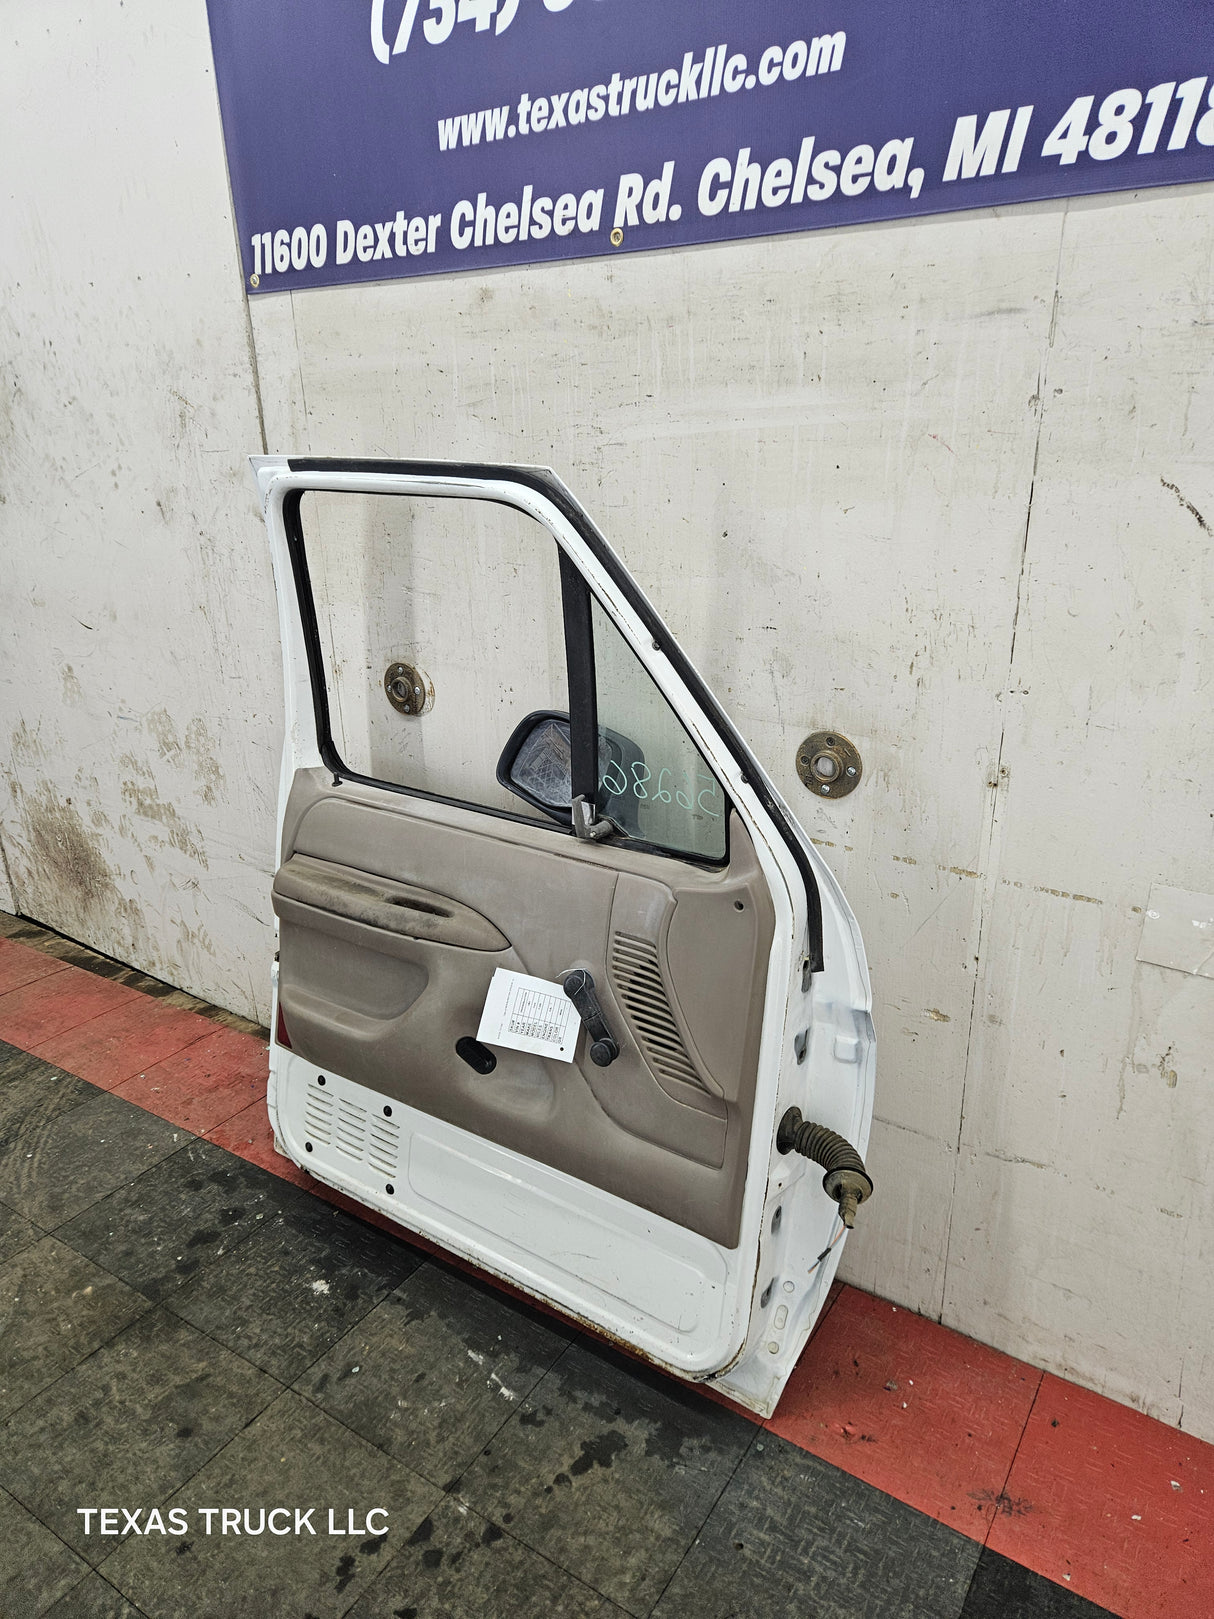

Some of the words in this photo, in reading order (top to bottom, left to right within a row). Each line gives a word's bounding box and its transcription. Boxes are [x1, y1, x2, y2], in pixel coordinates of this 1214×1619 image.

[437, 31, 847, 151] www.texastruckllc.com
[251, 222, 328, 275] 11600
[335, 210, 442, 265] Dexter
[450, 184, 605, 250] Chelsea
[613, 160, 682, 229] Rd.
[697, 136, 925, 217] Chelsea,
[942, 104, 1034, 182] MI
